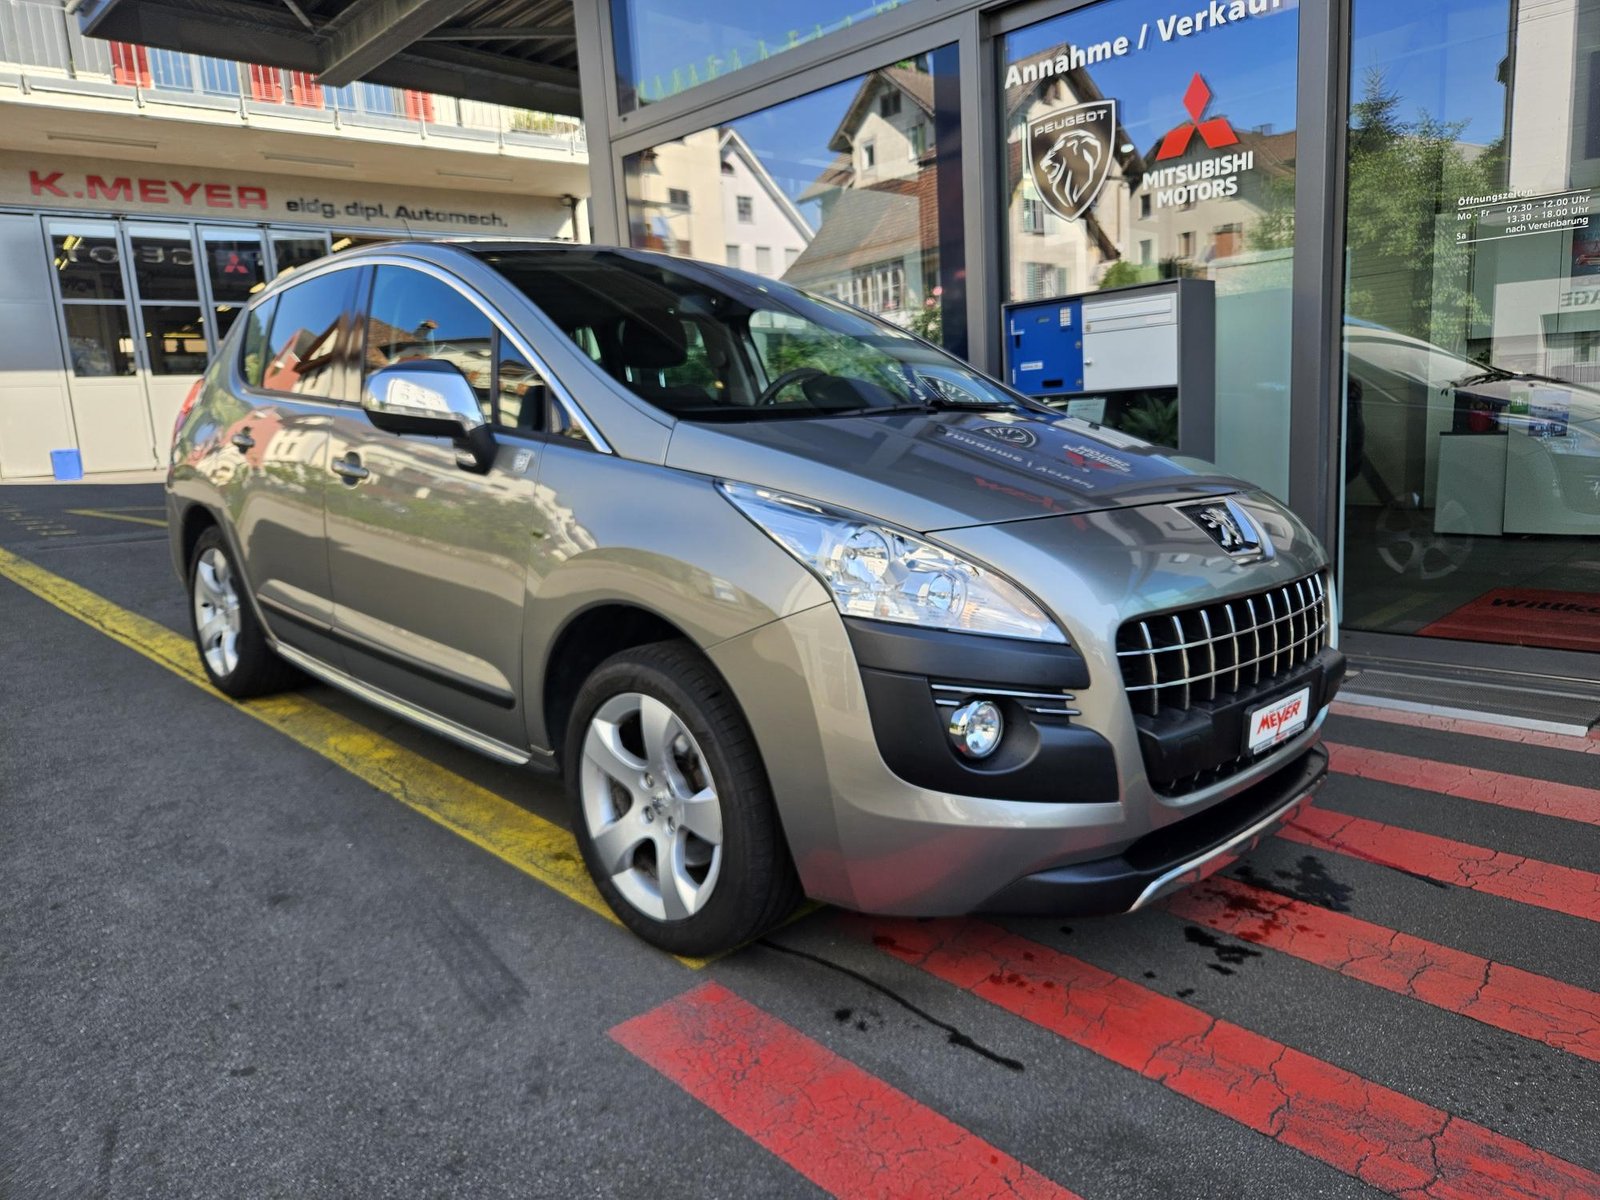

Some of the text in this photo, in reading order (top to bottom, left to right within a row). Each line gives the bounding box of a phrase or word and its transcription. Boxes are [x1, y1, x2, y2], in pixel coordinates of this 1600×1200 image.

[1005, 36, 1128, 89] Annahme
[1138, 23, 1148, 50] /
[1034, 109, 1108, 137] PEUGEOT
[1142, 151, 1254, 190] MITSUBISHI
[1156, 176, 1238, 208] MOTORS
[394, 205, 509, 228] Automech.
[1457, 212, 1472, 221] Mo
[1481, 209, 1490, 217] Fr
[1506, 203, 1532, 214] 07.30
[1543, 198, 1568, 208] 12.00
[1571, 195, 1590, 204] Uhr
[1507, 213, 1532, 224] 13.30
[1542, 208, 1568, 219] 18.00
[1571, 206, 1589, 215] Uhr
[1456, 216, 1589, 240] Sa nach Vereinbarung
